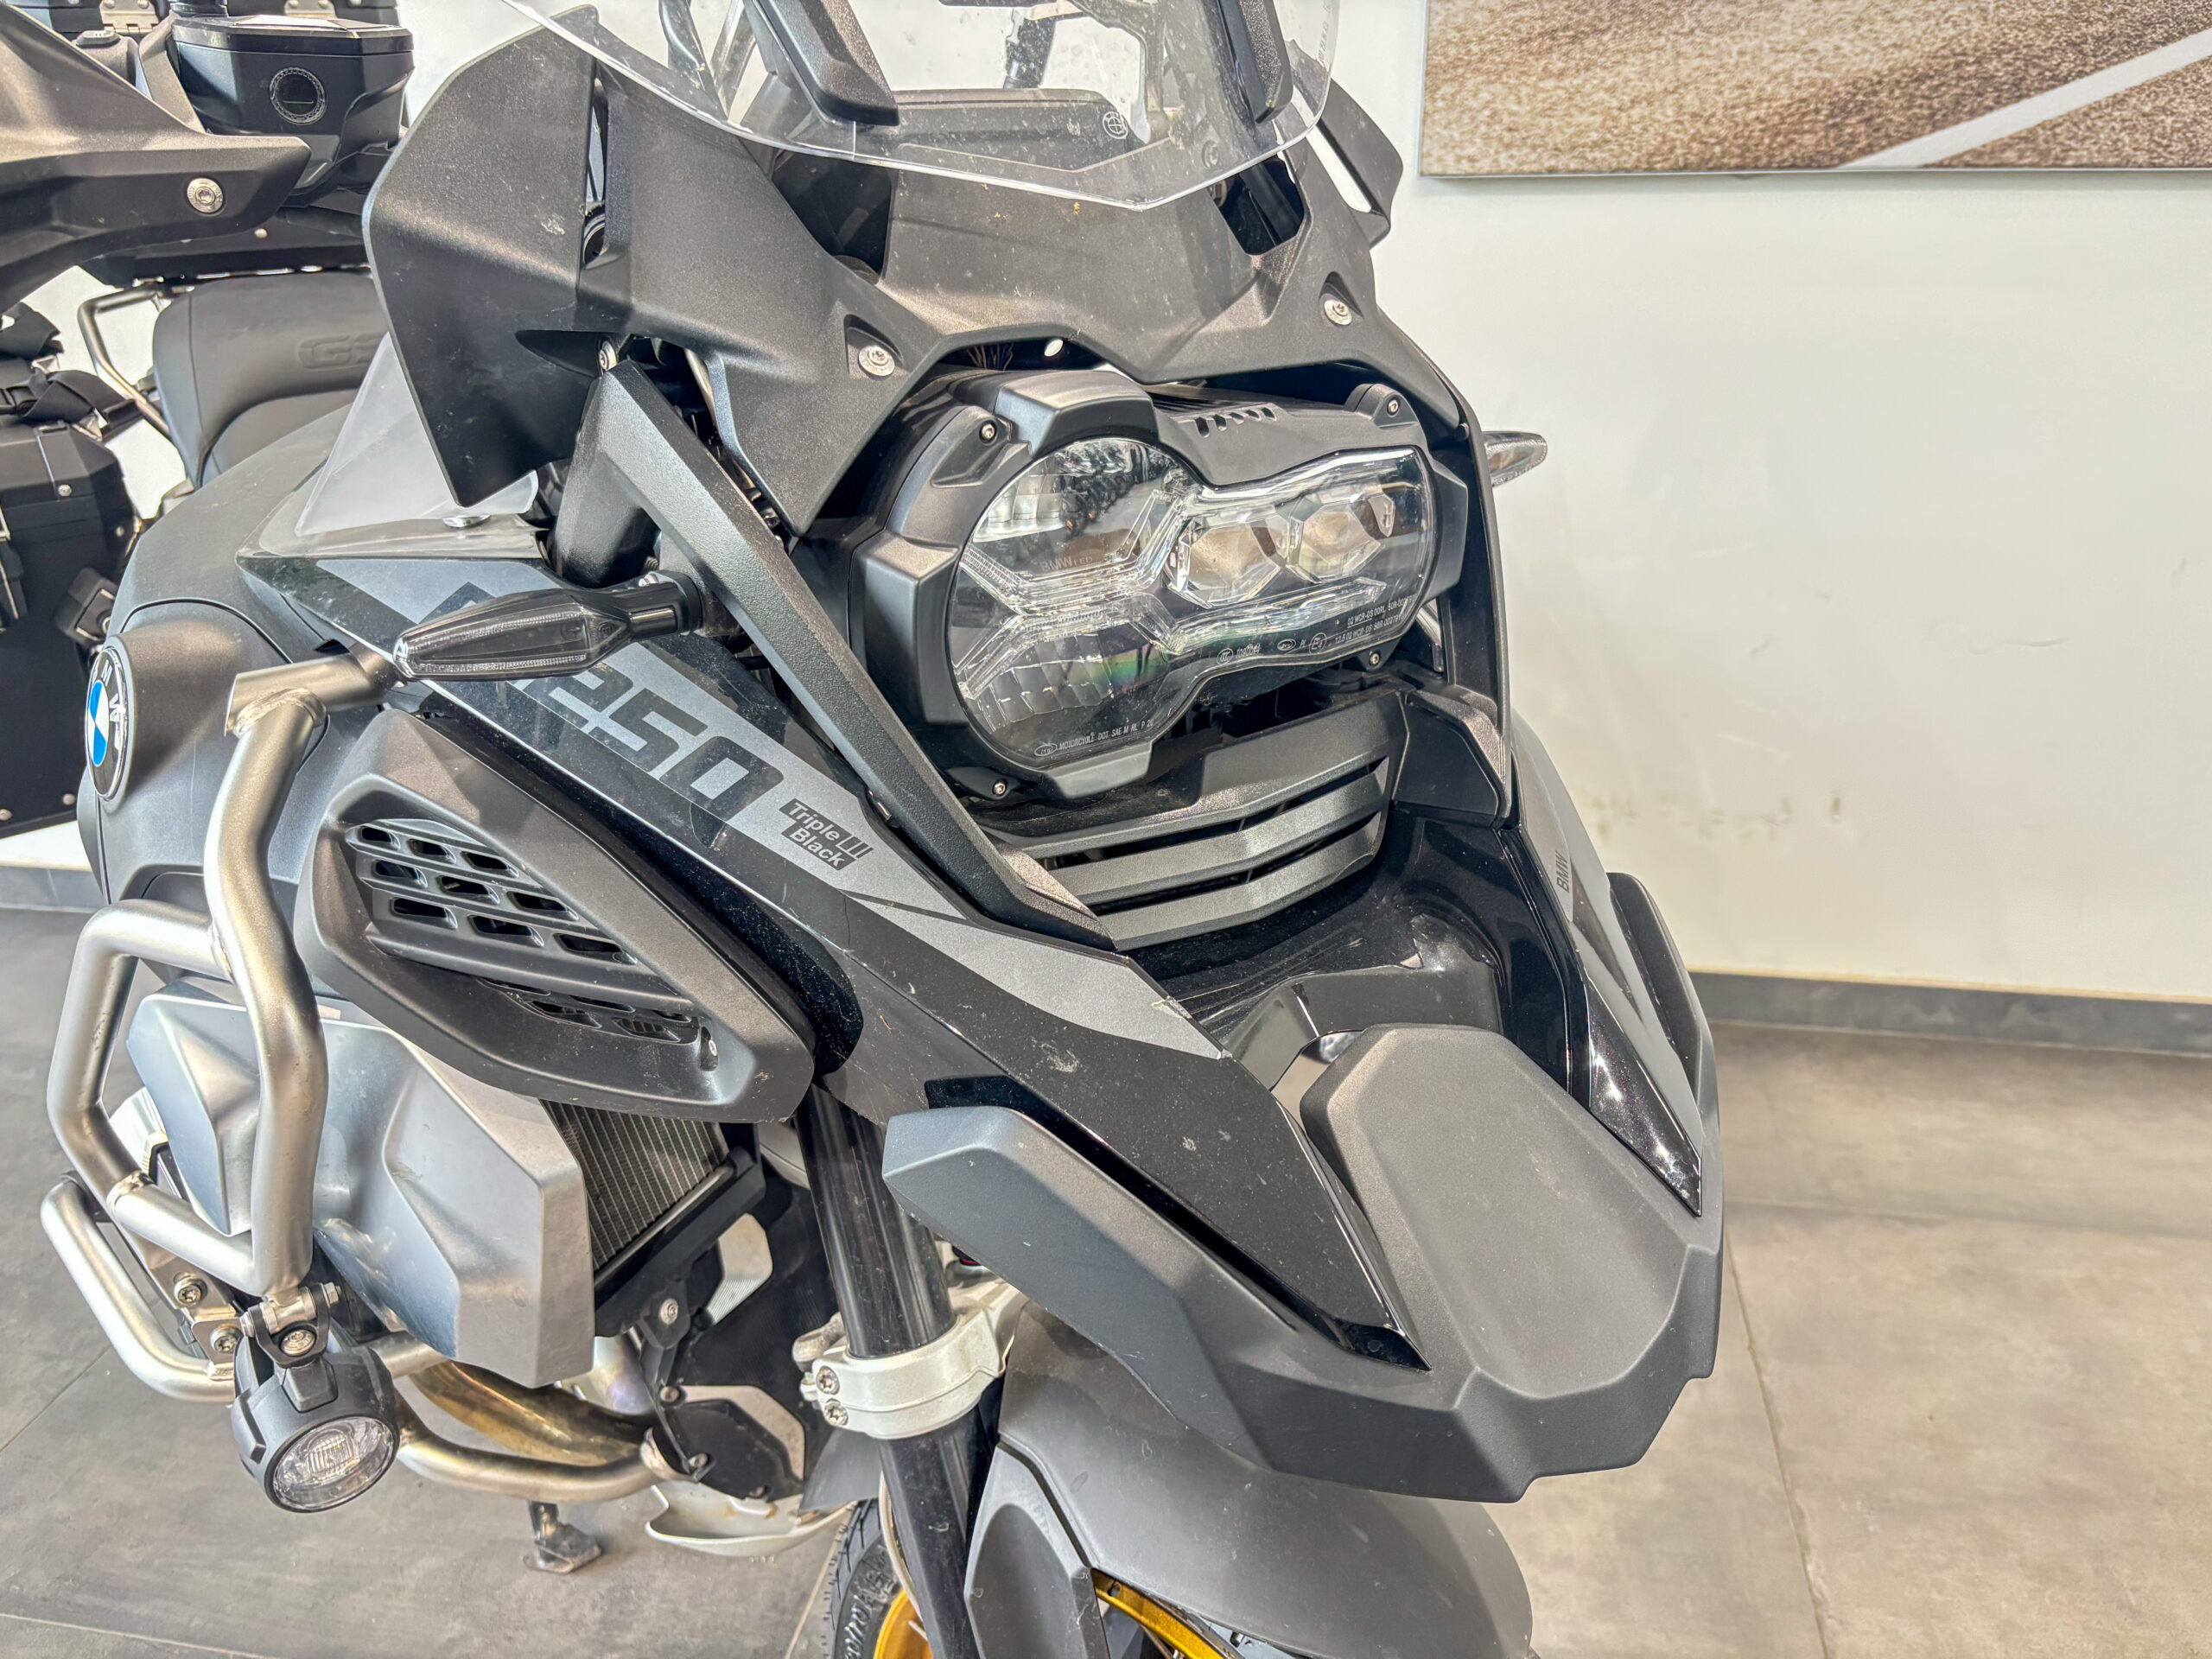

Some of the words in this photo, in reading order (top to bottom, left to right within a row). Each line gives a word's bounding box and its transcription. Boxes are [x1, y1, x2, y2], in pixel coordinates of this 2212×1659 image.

[1039, 556, 1072, 571] BMW
[1097, 731, 1109, 741] DOT
[1111, 728, 1122, 737] SAE
[789, 802, 840, 841] Triple
[789, 827, 845, 867] Black
[1554, 850, 1570, 893] BMW
